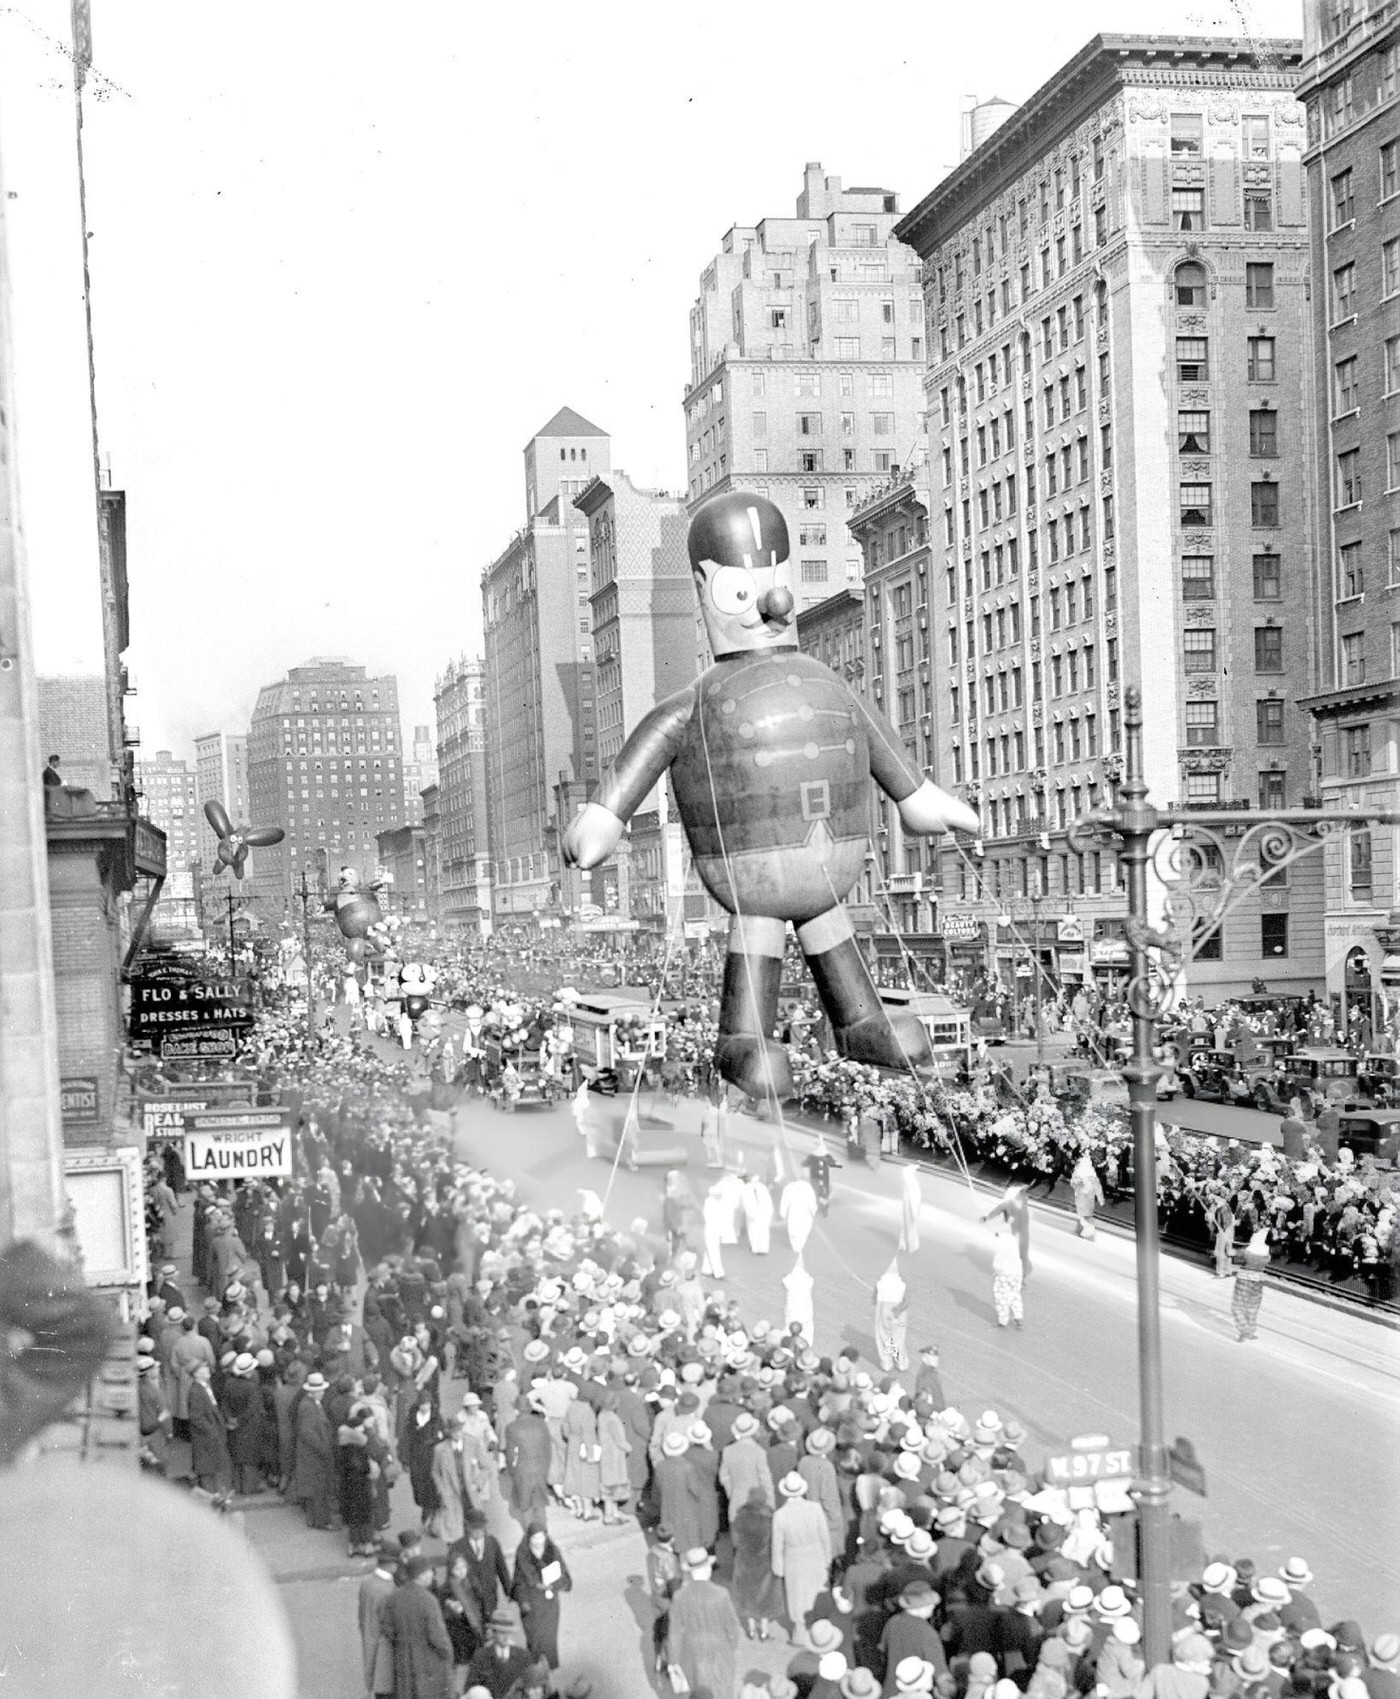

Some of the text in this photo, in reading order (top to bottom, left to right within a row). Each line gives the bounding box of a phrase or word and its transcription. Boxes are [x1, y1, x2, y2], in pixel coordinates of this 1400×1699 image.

[142, 985, 241, 1002] FLO & SALLY
[140, 1010, 199, 1023] DRESSES
[213, 1007, 247, 1019] HATS
[62, 1092, 97, 1108] ENTIST
[211, 1132, 263, 1144] WRIGHT
[190, 1137, 285, 1170] LAUNDRY
[1072, 1453, 1101, 1478] 97
